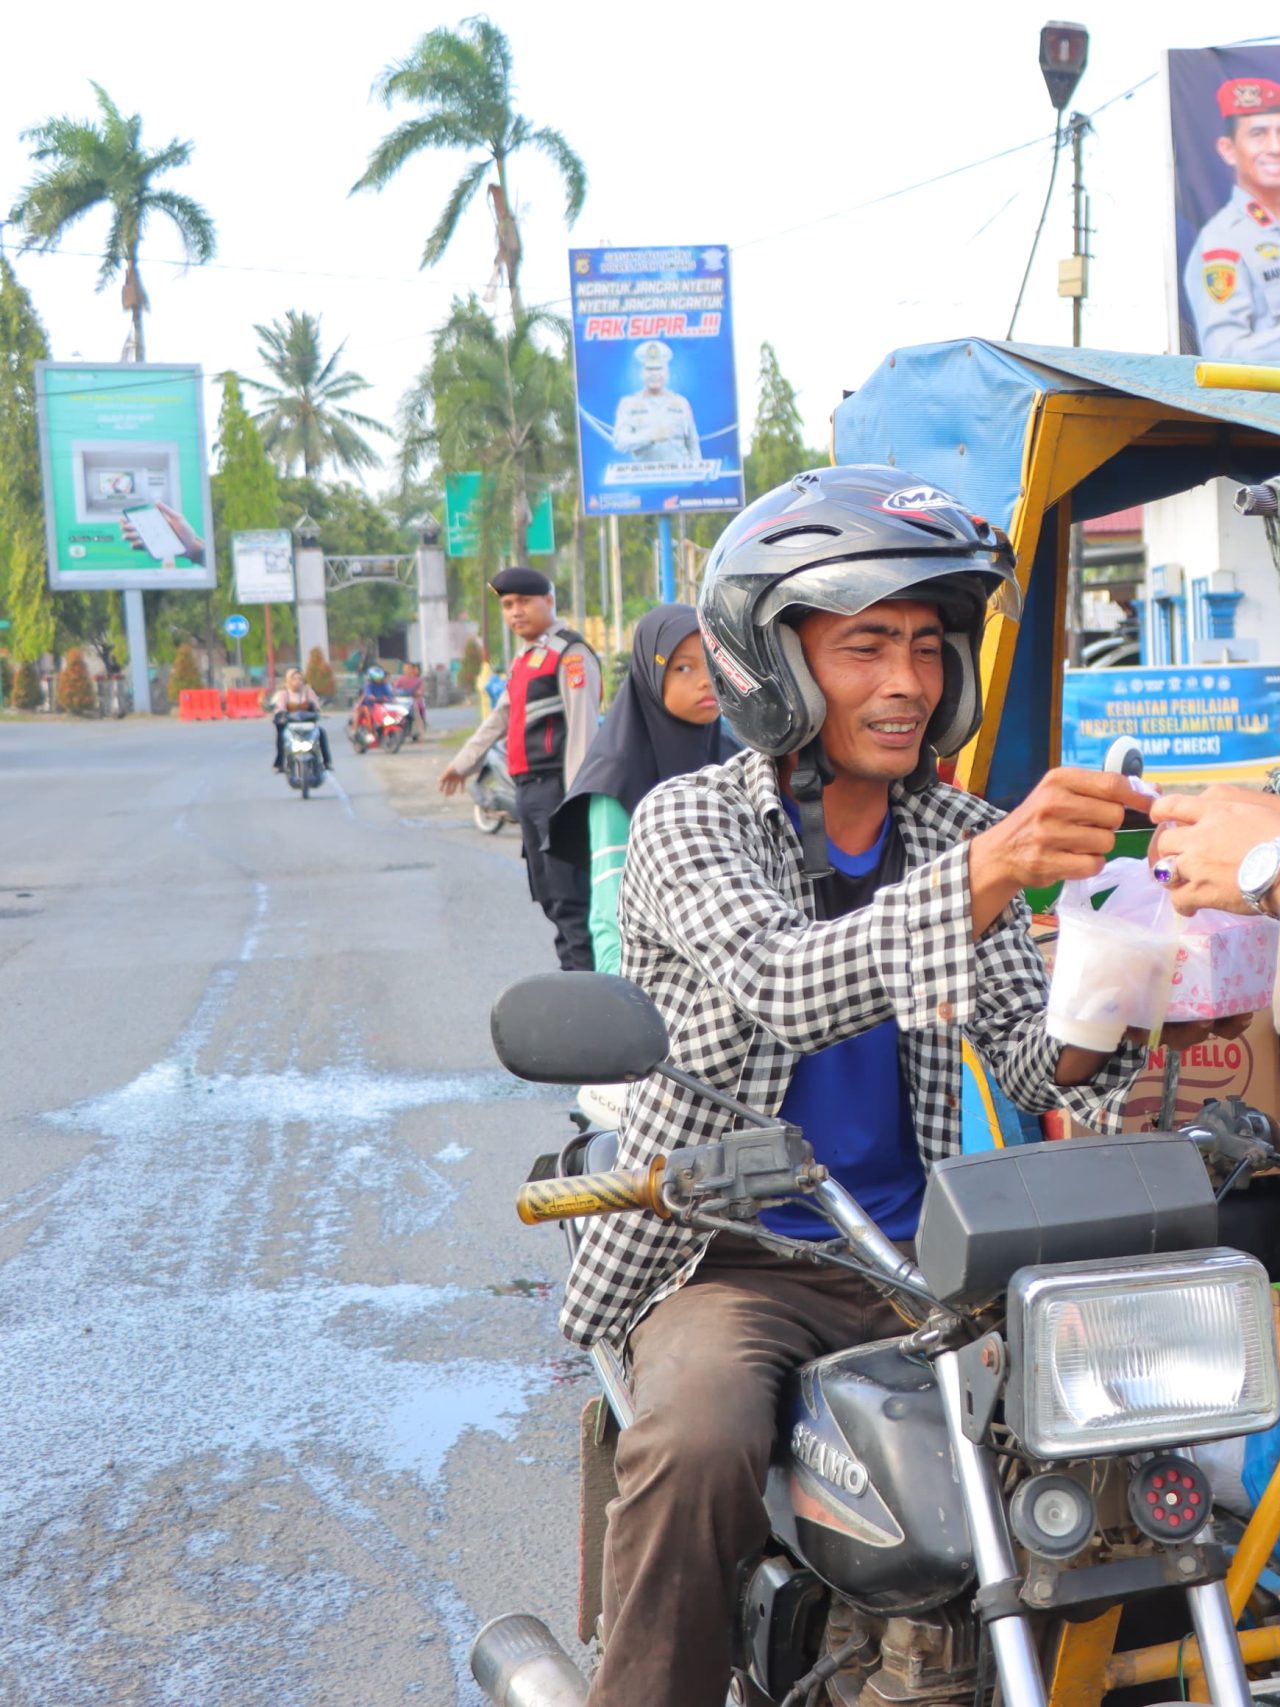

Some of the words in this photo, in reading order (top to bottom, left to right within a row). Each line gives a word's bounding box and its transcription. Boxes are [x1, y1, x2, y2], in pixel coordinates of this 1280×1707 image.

[586, 317, 624, 338] PAK
[1106, 701, 1168, 717] KEGIATAN
[1172, 698, 1239, 715] PENILAIAN
[1081, 719, 1138, 737] INSPEKSI
[1142, 716, 1234, 735] KESELAMATAN
